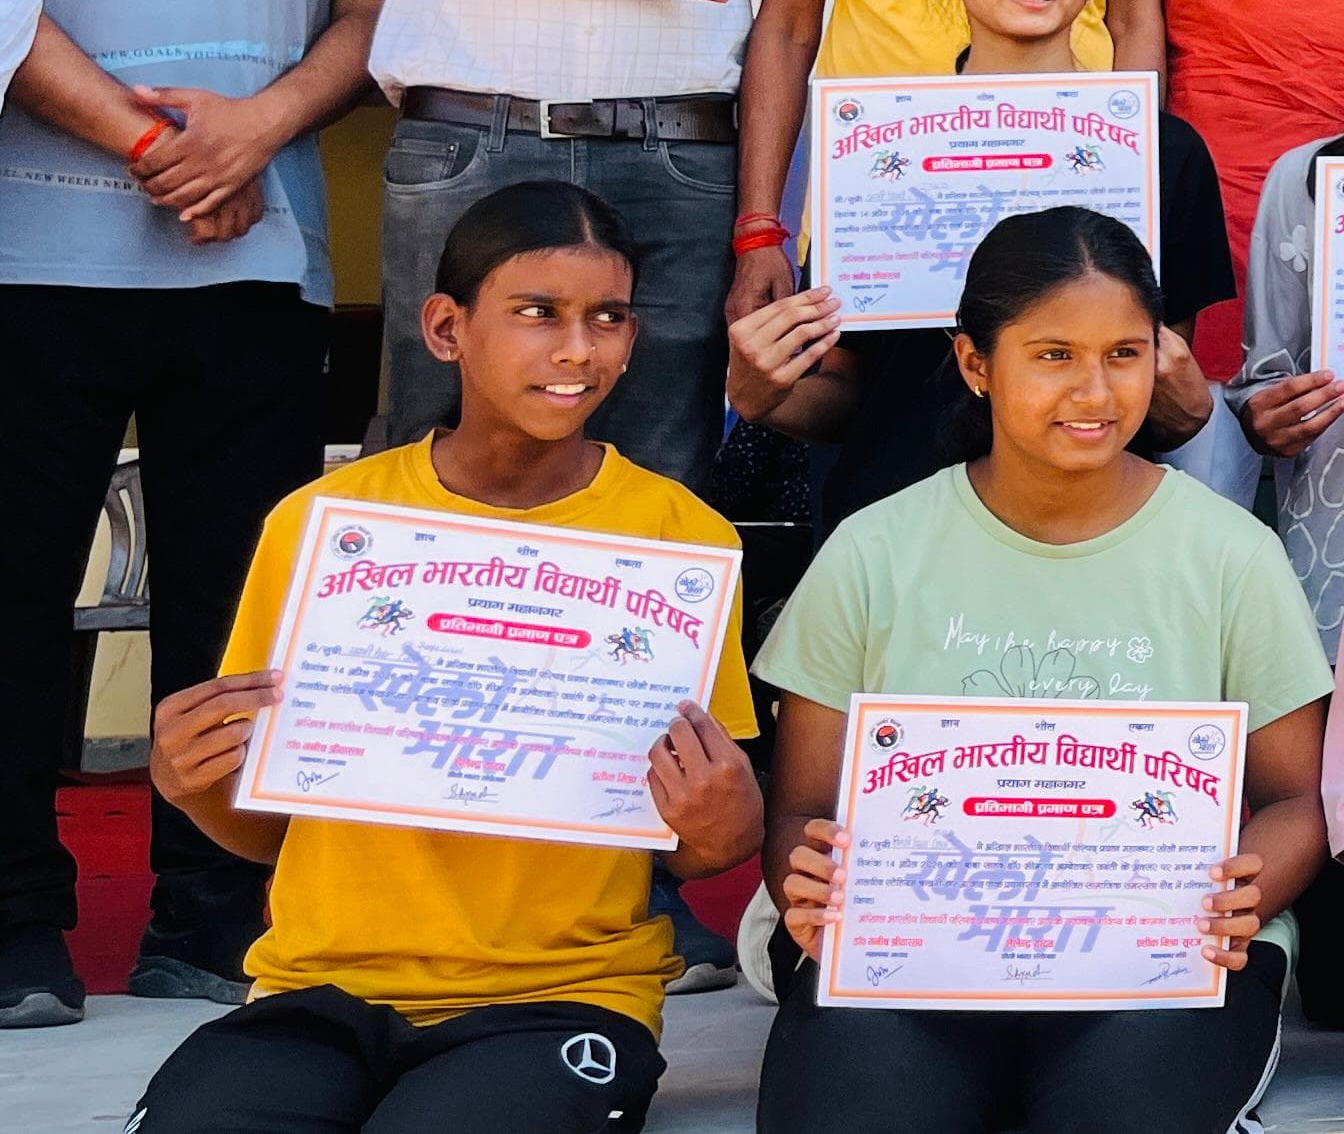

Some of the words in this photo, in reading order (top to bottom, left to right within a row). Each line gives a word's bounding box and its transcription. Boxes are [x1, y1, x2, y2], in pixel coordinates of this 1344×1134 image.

[833, 120, 903, 159] अखिल
[319, 558, 417, 598] अखिल
[422, 555, 528, 589] भारतीय
[533, 560, 620, 608] विद्यार्थी
[1028, 676, 1095, 699] every
[862, 749, 946, 794] अखिल
[952, 733, 1048, 768] भारतीय
[1055, 733, 1136, 773] विद्यार्थी
